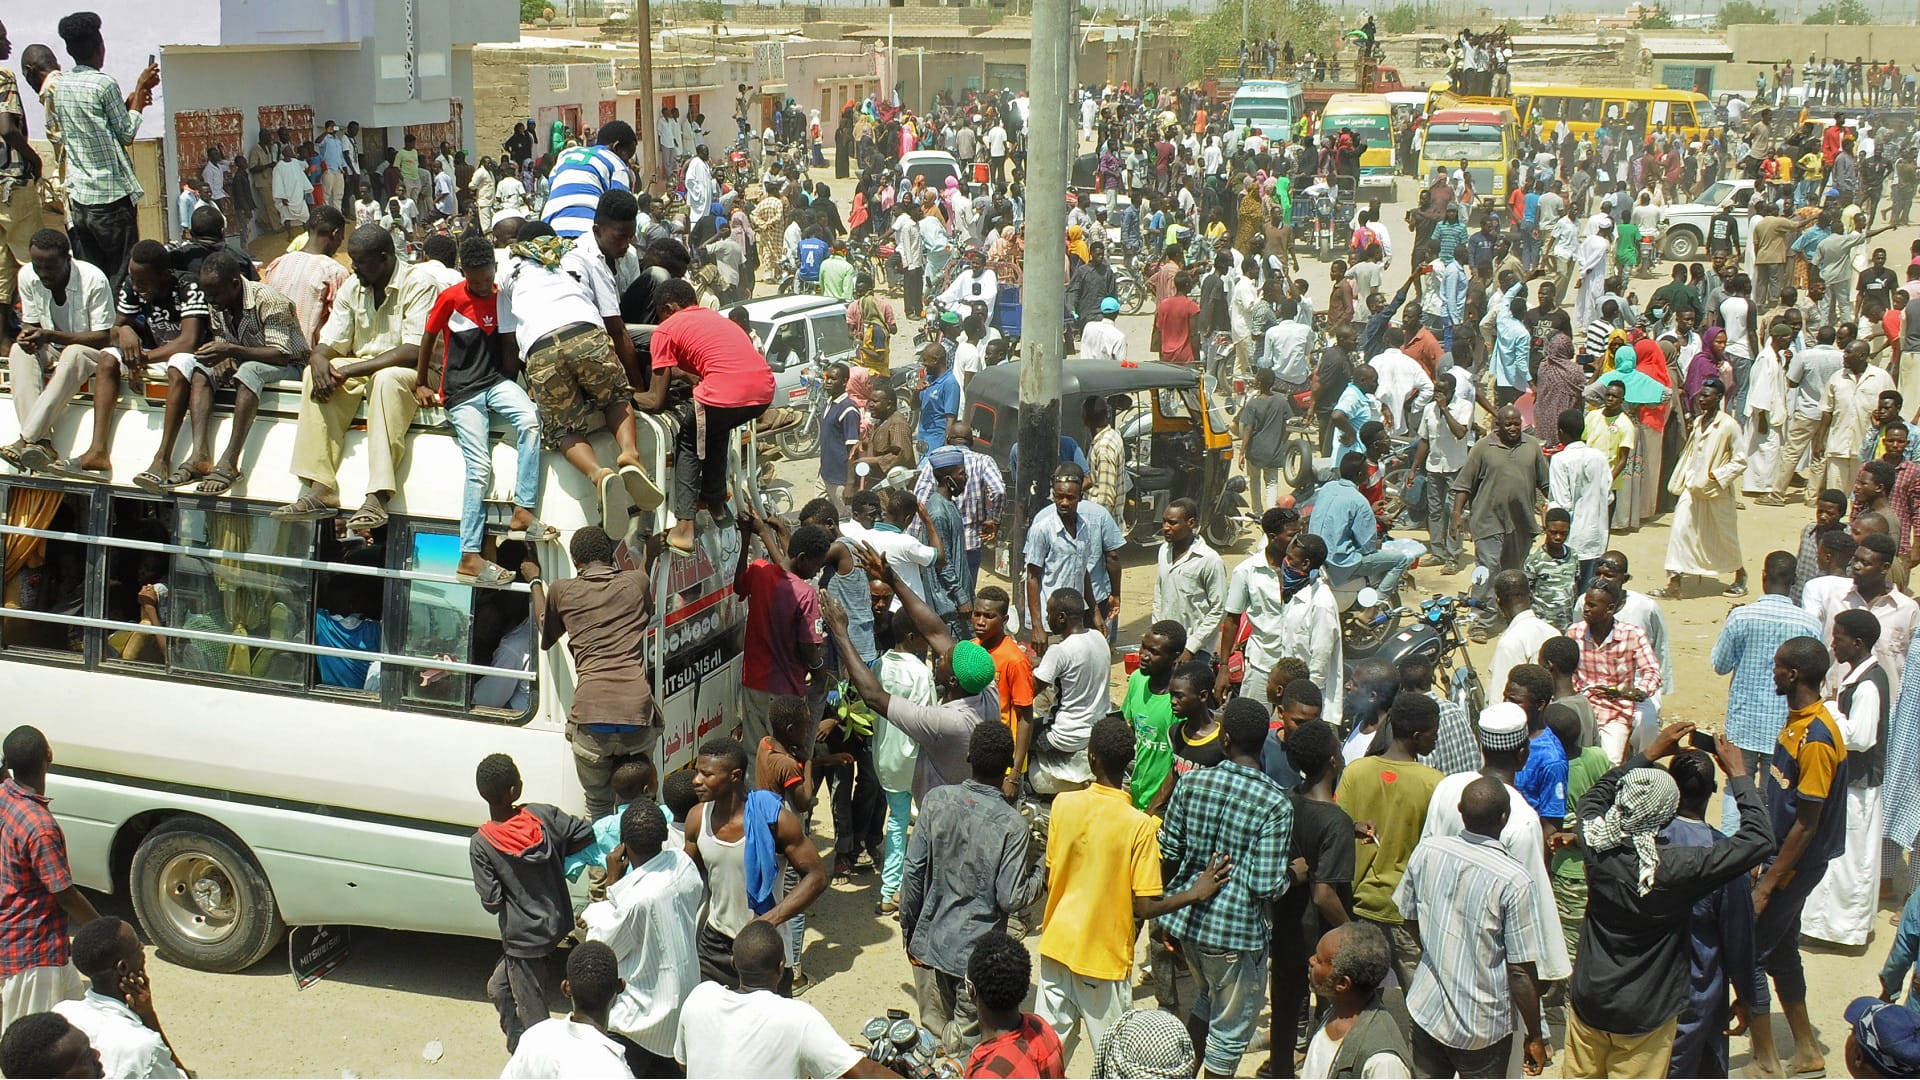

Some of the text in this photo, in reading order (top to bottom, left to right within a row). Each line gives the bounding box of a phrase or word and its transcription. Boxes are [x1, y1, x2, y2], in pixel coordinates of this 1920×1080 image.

[805, 250, 815, 267] 4
[186, 290, 205, 304] 22
[152, 309, 170, 322] 22
[663, 648, 722, 696] ITSUBISHI
